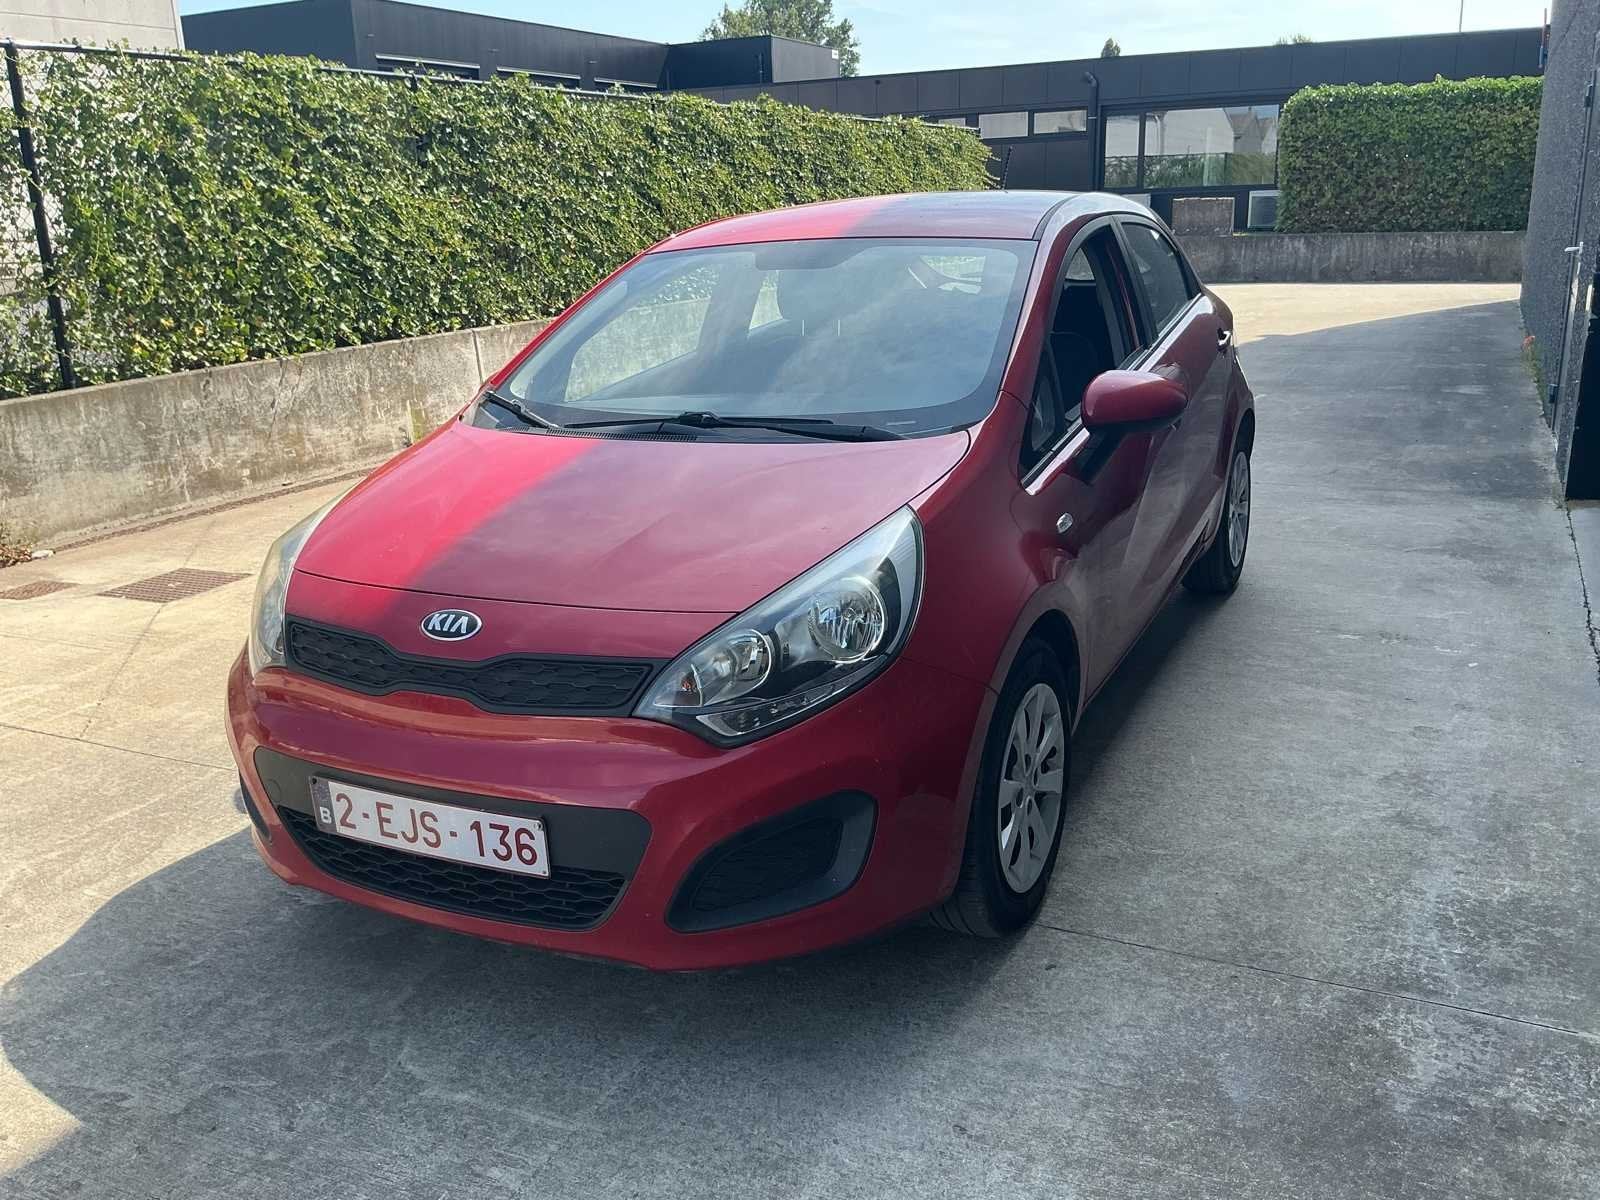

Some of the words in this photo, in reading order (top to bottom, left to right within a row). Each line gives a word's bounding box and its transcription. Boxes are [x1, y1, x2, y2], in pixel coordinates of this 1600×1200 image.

[427, 613, 469, 634] KIA
[319, 806, 332, 825] B
[335, 792, 539, 866] 2-EJS-136
